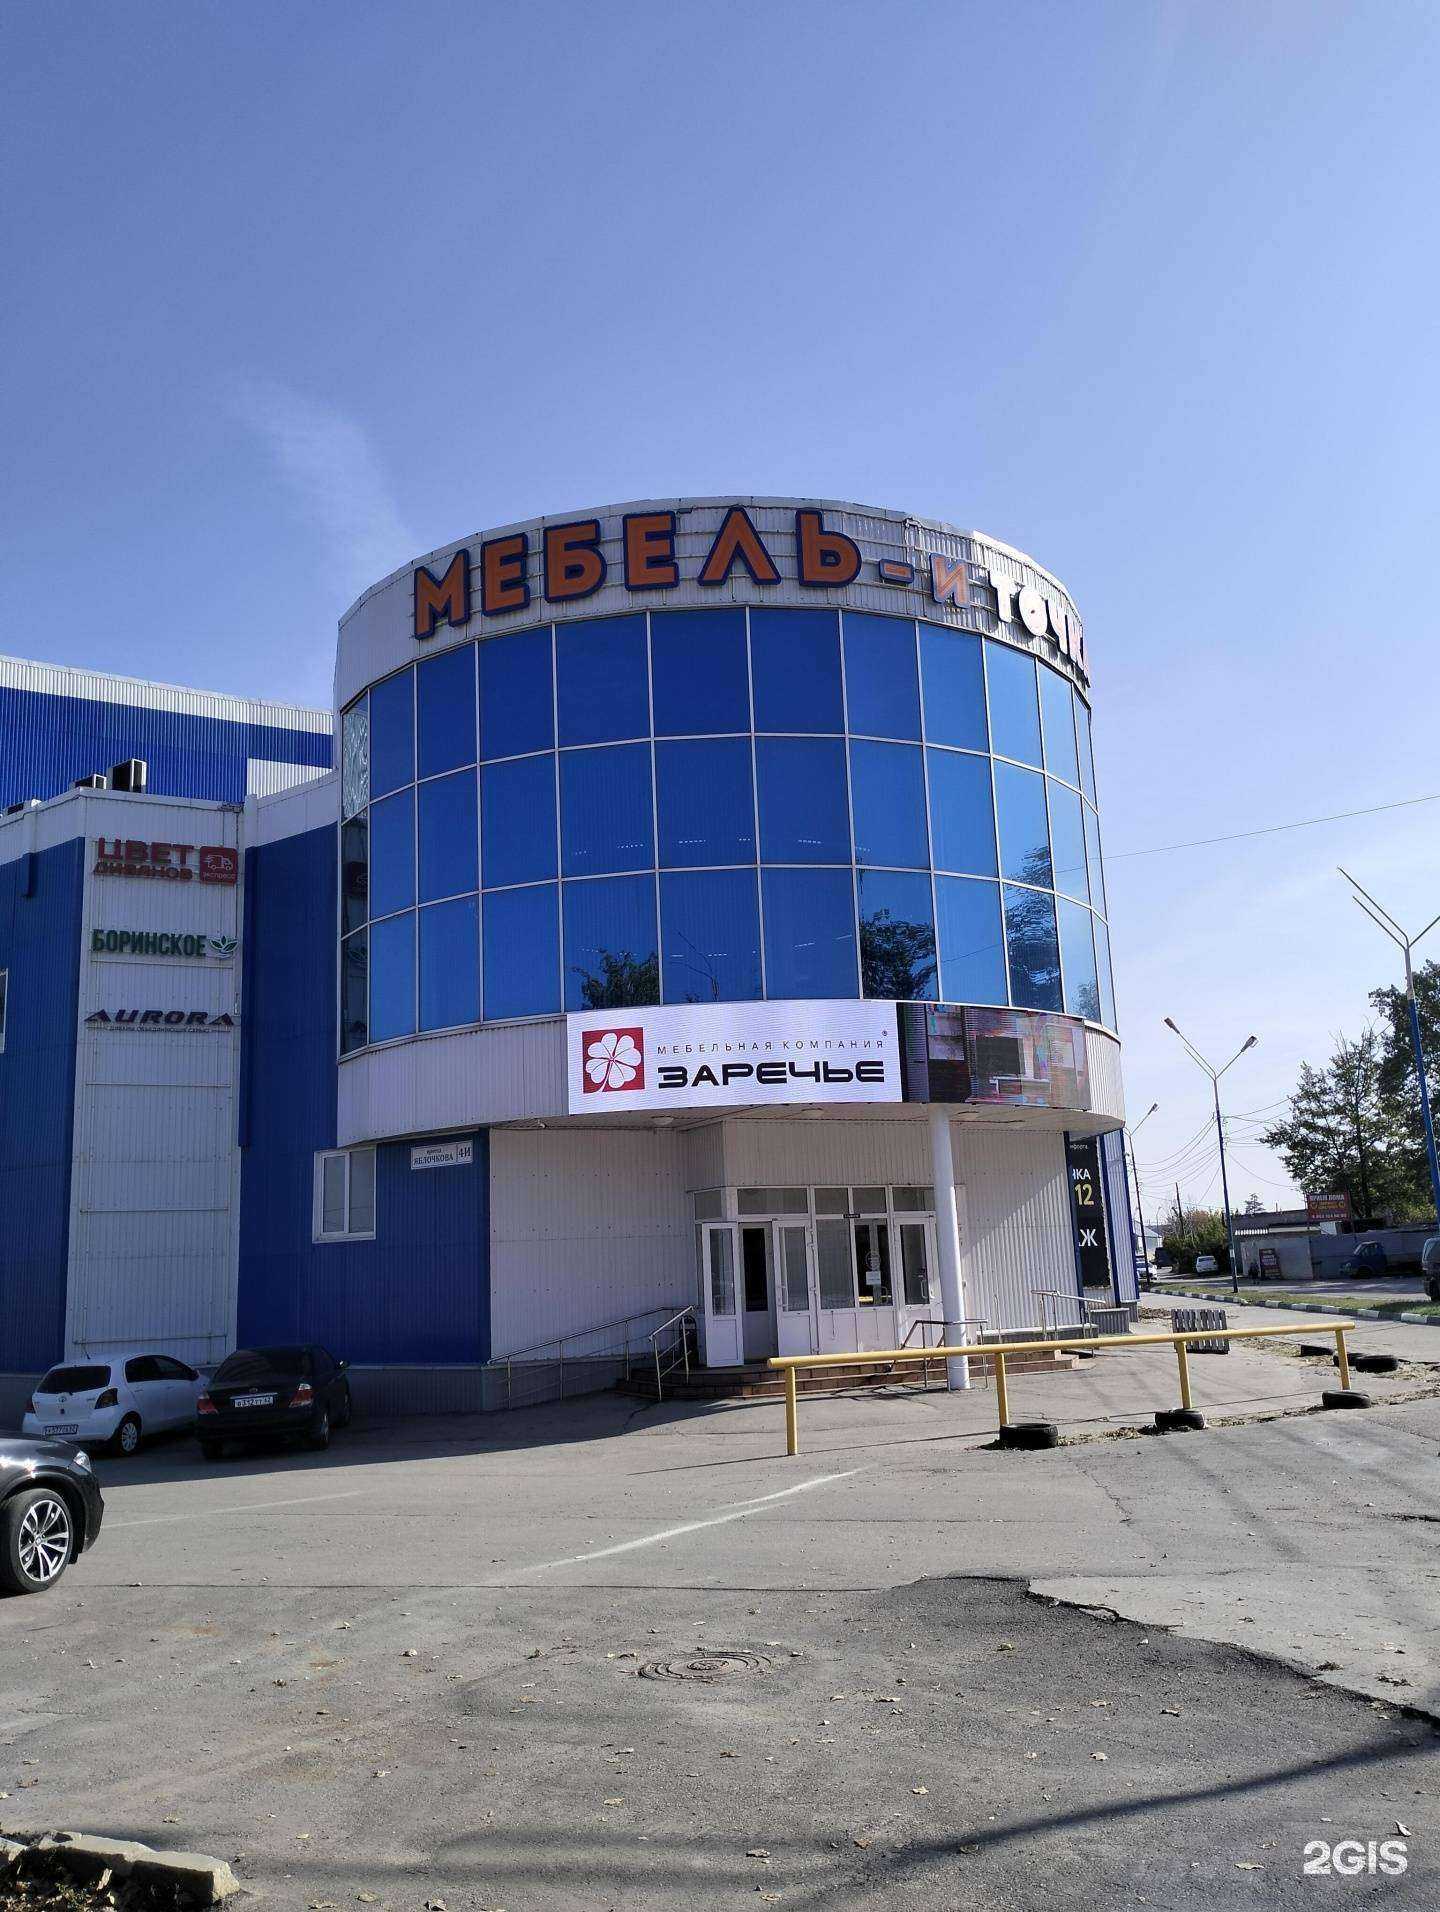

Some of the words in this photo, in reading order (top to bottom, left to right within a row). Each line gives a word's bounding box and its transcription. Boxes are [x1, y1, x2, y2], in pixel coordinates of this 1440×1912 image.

[414, 506, 861, 639] МЕБЕЛЬ
[988, 569, 1090, 687] ТОЧК
[98, 837, 194, 865] ЦВЕТ
[92, 929, 206, 957] БОРИНСКОЕ
[84, 1009, 234, 1025] AURORA
[657, 1042, 772, 1054] МЕБЕЛЬНАЯ
[783, 1040, 883, 1050] КОМПАНИЯ
[658, 1060, 884, 1089] ЗАРЕЧЬЕ
[413, 1152, 453, 1166] ЯБЛОЧКОВА
[1075, 1184, 1094, 1206] 12
